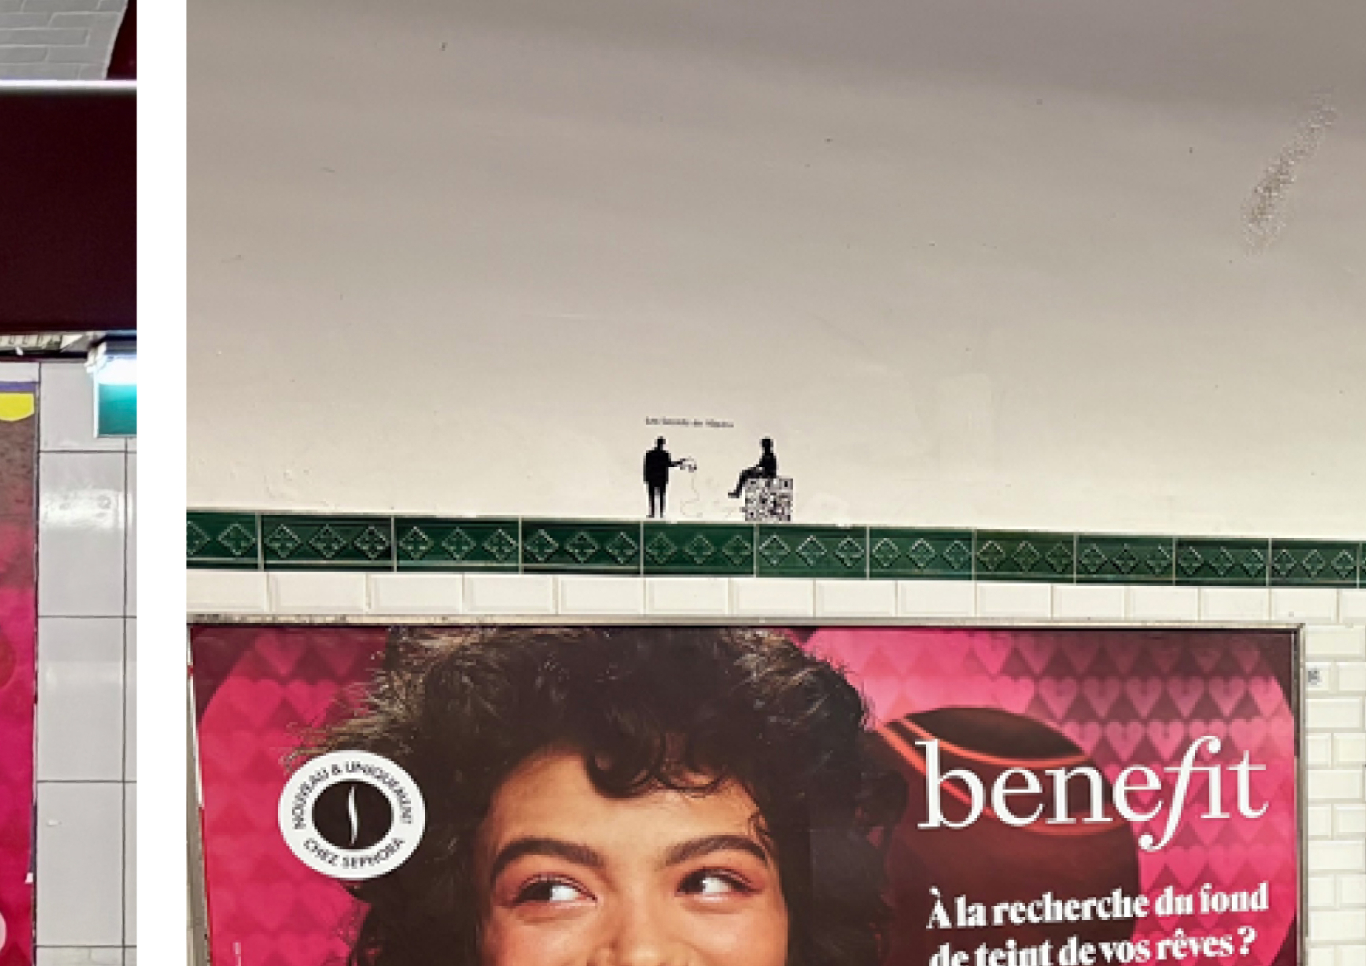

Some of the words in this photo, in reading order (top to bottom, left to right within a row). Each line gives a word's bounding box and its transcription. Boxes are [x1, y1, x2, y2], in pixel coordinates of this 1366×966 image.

[915, 736, 1269, 852] benefit
[926, 886, 952, 929] À
[955, 894, 986, 928] la
[992, 888, 1150, 926] recherche
[1155, 886, 1194, 916] du
[1199, 880, 1269, 914] fond
[1099, 939, 1151, 965] vos
[1155, 927, 1235, 960] rêves
